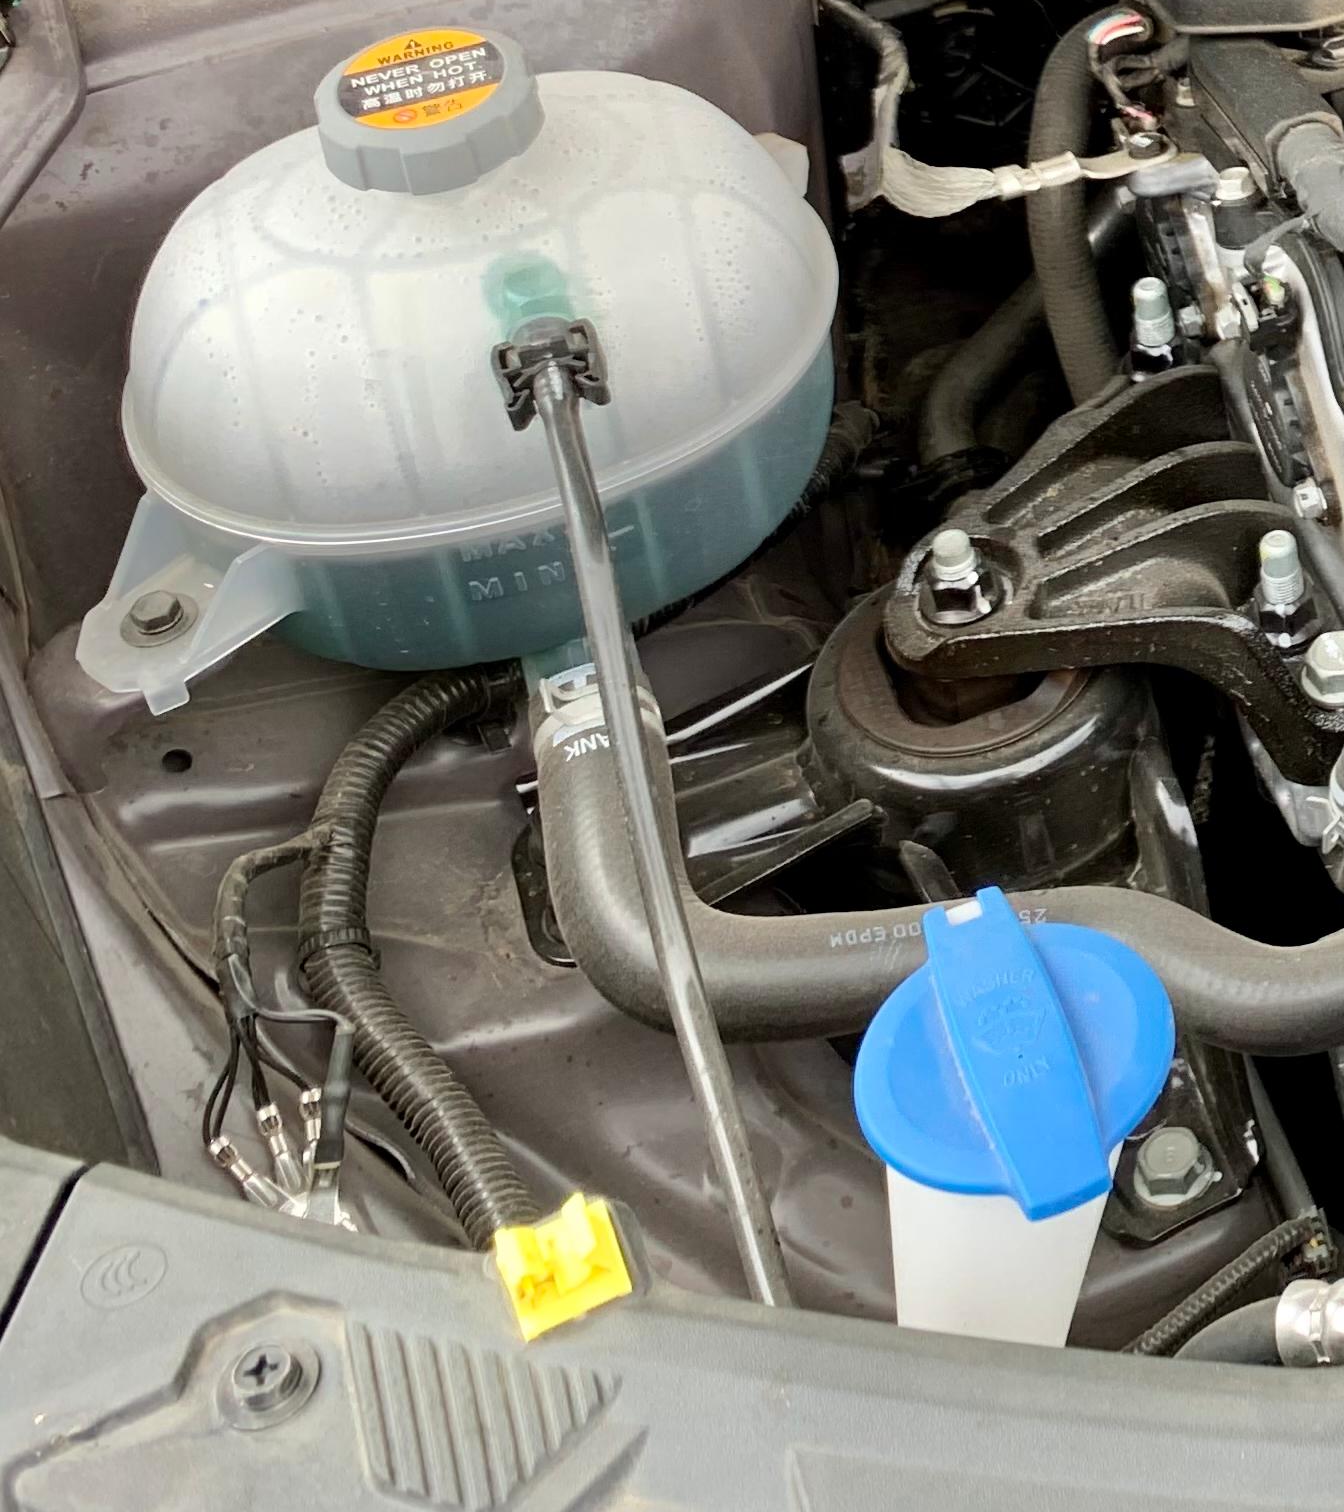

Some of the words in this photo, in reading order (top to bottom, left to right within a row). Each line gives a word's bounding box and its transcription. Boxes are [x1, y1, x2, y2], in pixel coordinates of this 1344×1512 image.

[350, 64, 420, 88] NEVER
[429, 47, 487, 69] OPEN
[377, 41, 454, 66] WARNING
[363, 75, 424, 96] WHEN
[433, 62, 483, 81] HOT.
[468, 561, 566, 601] MIN
[564, 732, 610, 762] ANK
[830, 925, 885, 948] EPDM
